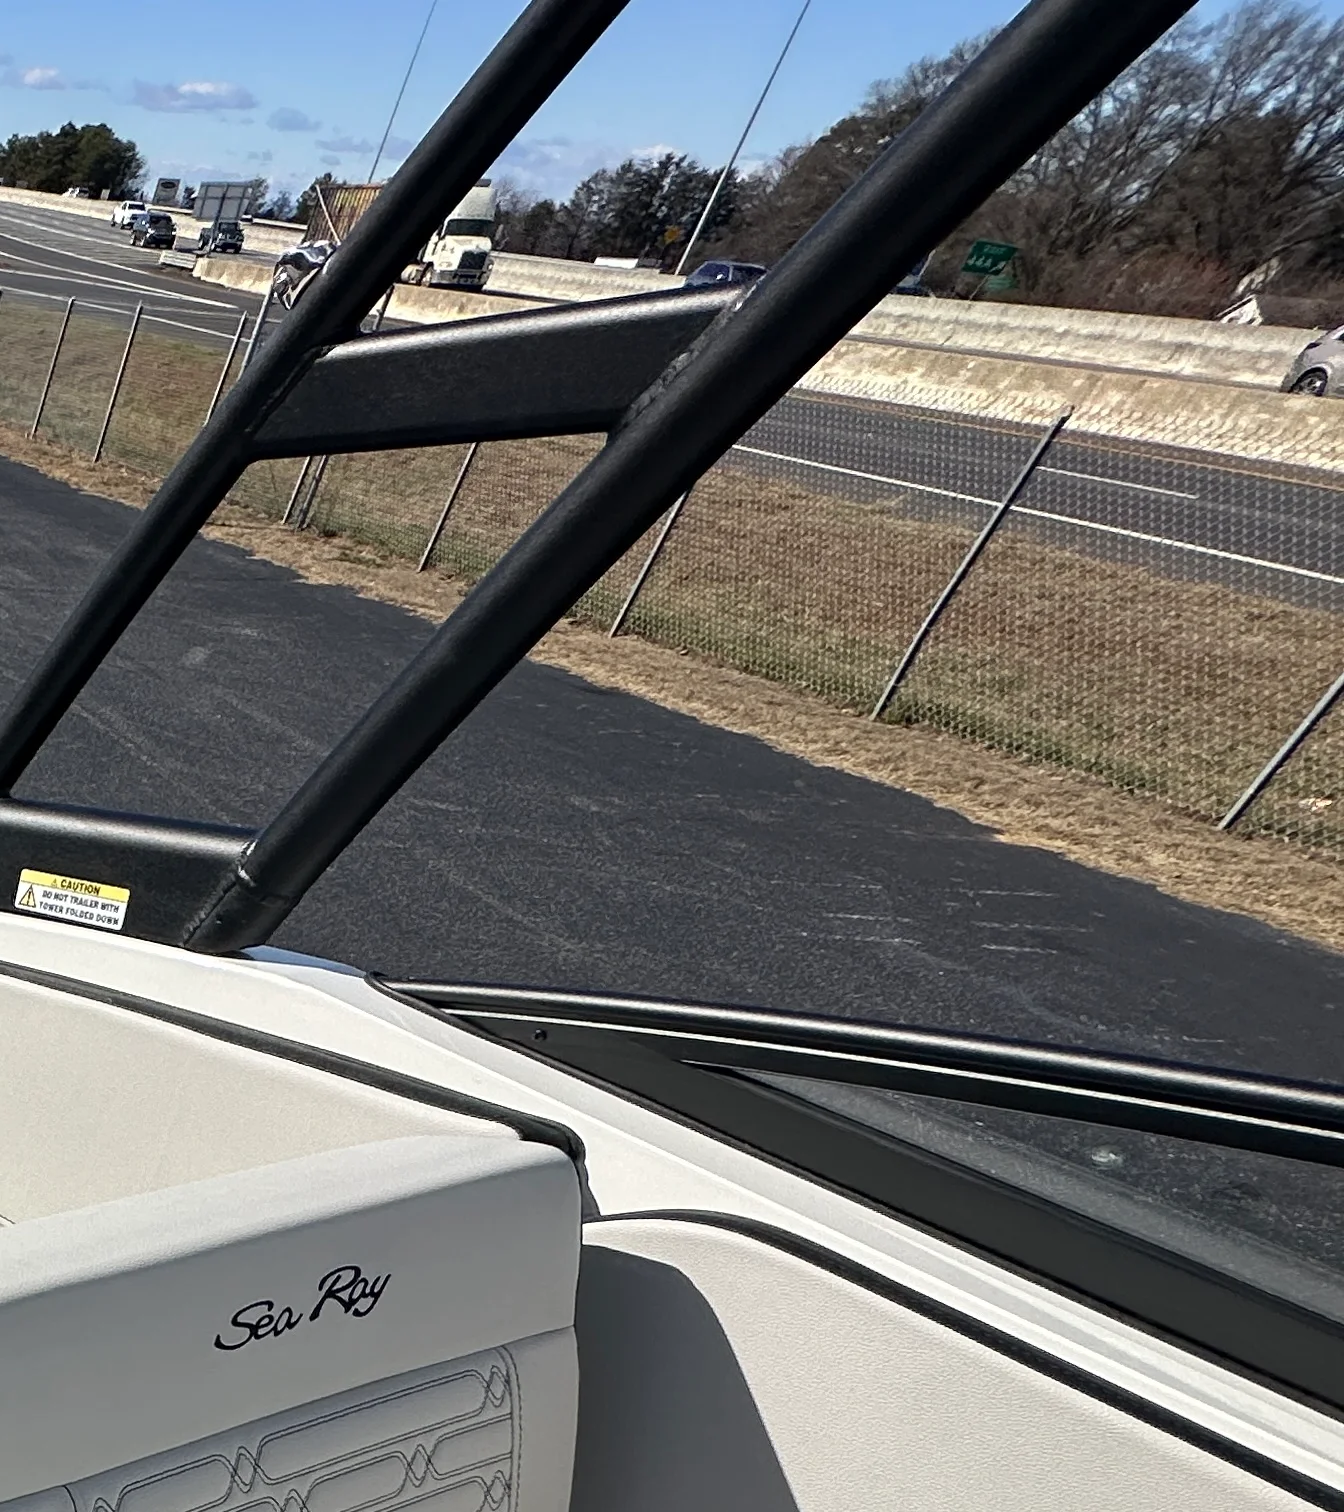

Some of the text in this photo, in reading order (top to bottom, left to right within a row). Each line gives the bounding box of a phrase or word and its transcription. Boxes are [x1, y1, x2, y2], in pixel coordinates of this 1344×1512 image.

[60, 879, 102, 896] CAUTION
[39, 901, 119, 926] TOWER FOLDED DOWN
[42, 890, 120, 914] DO NOT TRAILER WITH
[214, 1265, 392, 1351] Sea Ray
